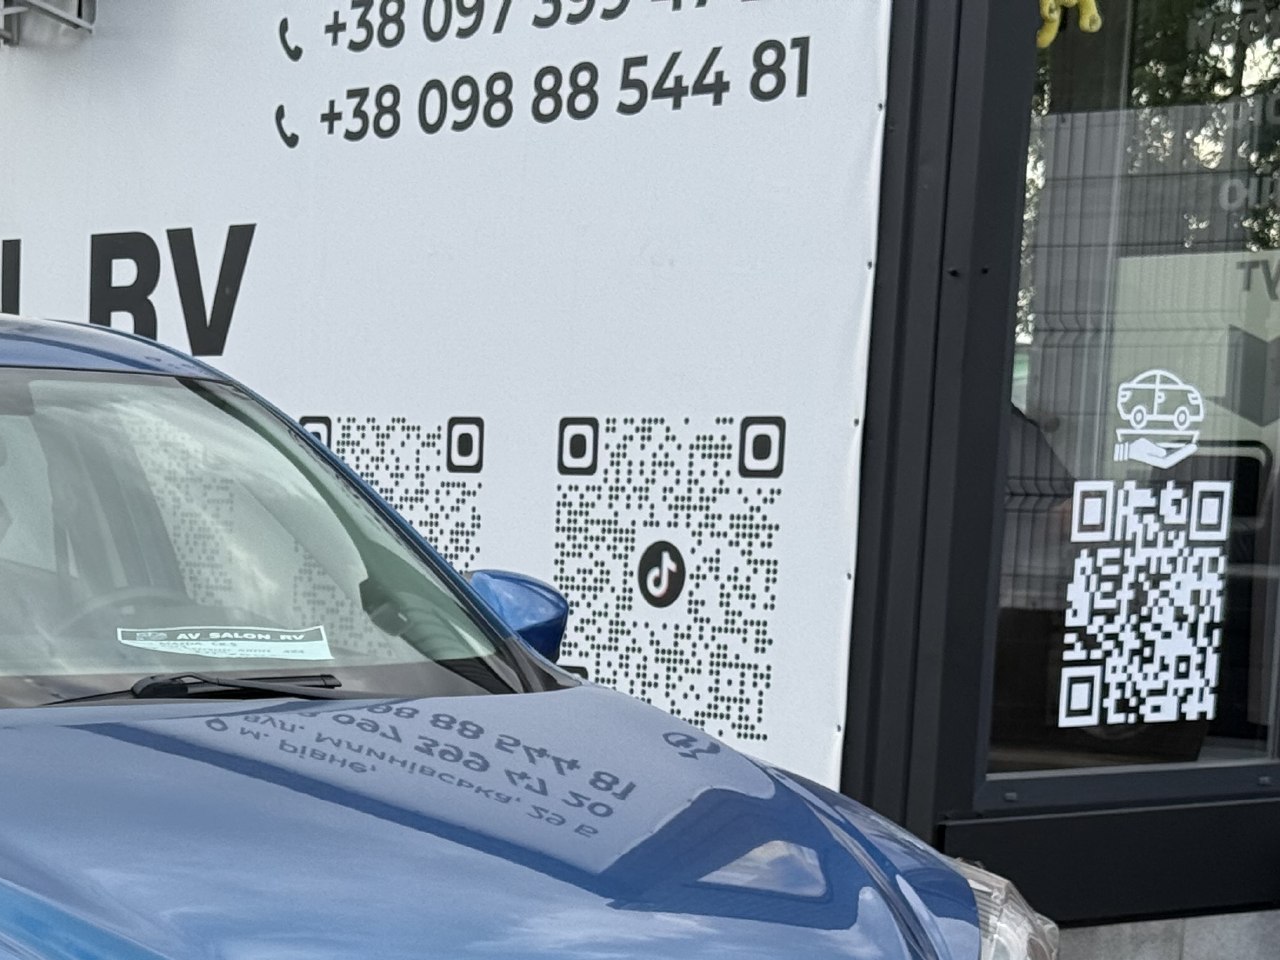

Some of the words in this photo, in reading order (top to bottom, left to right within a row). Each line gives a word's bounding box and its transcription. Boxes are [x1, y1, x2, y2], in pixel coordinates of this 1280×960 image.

[324, 0, 406, 53] +38
[319, 84, 401, 142] +38
[417, 72, 514, 135] 098
[531, 61, 599, 124] 88
[615, 46, 731, 116] 544
[749, 35, 811, 102] 81
[89, 223, 258, 357] RV
